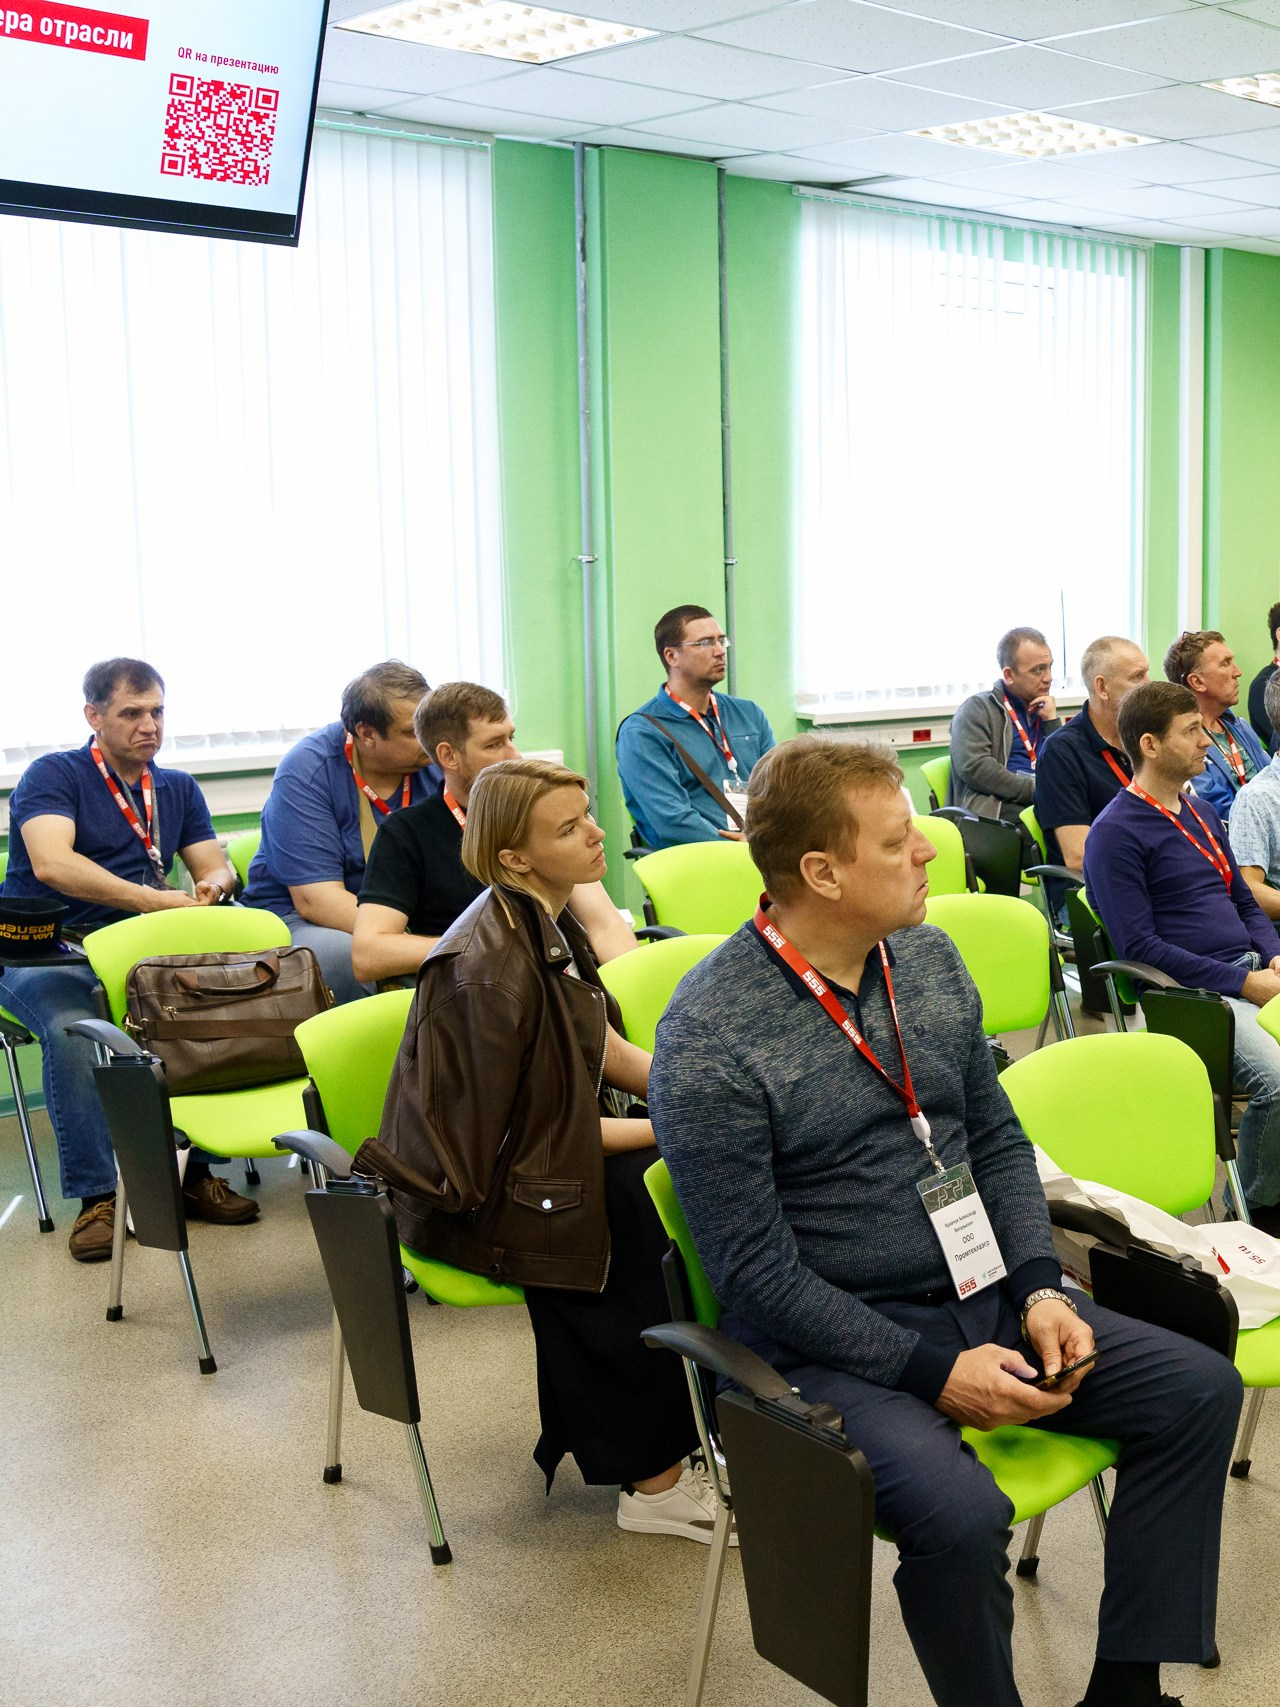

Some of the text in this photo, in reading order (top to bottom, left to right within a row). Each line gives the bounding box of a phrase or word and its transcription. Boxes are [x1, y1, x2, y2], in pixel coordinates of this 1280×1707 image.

[40, 17, 133, 50] отрасли
[178, 46, 279, 75] QR на презентацию
[33, 931, 54, 940] LADA
[762, 924, 787, 949] 555
[802, 970, 828, 997] 555
[842, 1019, 863, 1045] 555
[962, 1232, 975, 1244] ООО
[954, 1240, 990, 1262] Промтехлазер
[958, 1278, 977, 1296] 555
